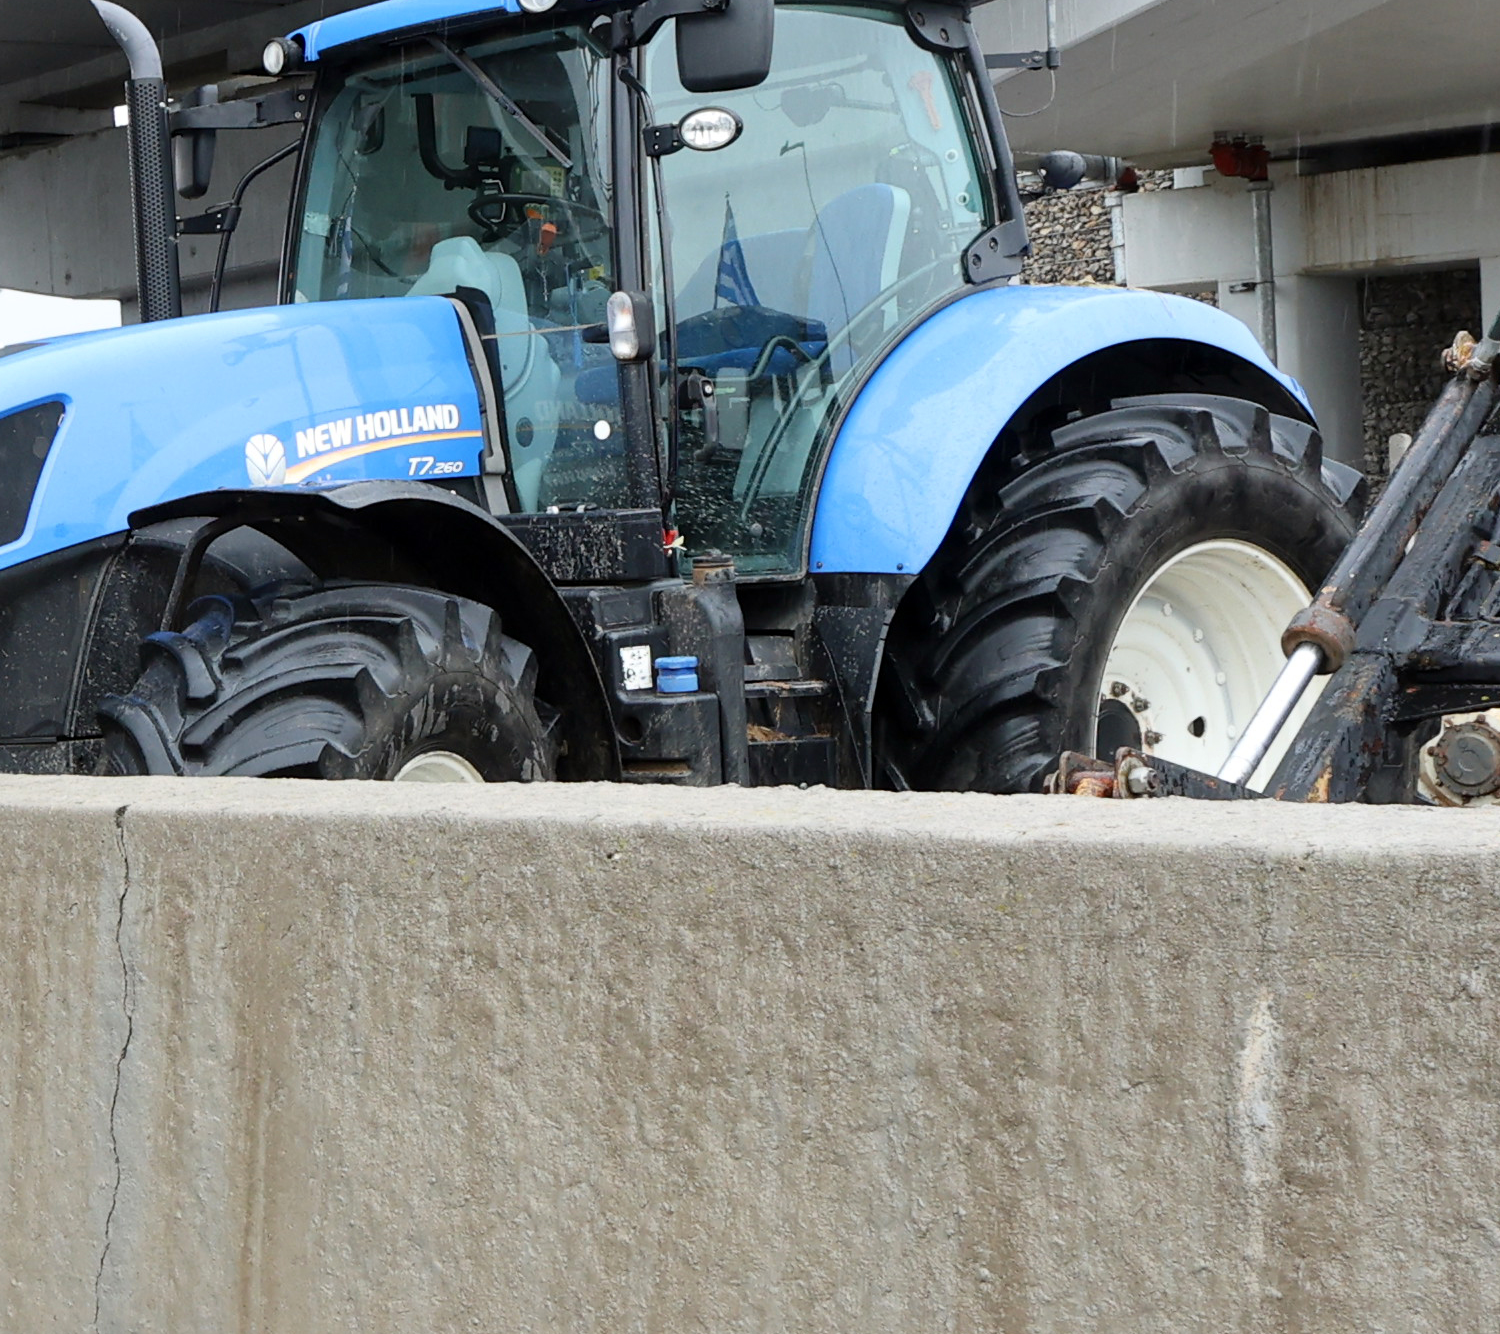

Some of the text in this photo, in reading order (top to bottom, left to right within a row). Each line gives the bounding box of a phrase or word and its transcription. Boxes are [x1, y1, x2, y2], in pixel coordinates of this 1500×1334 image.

[296, 404, 460, 458] NEW HOLLAND
[407, 456, 464, 476] T7.260
